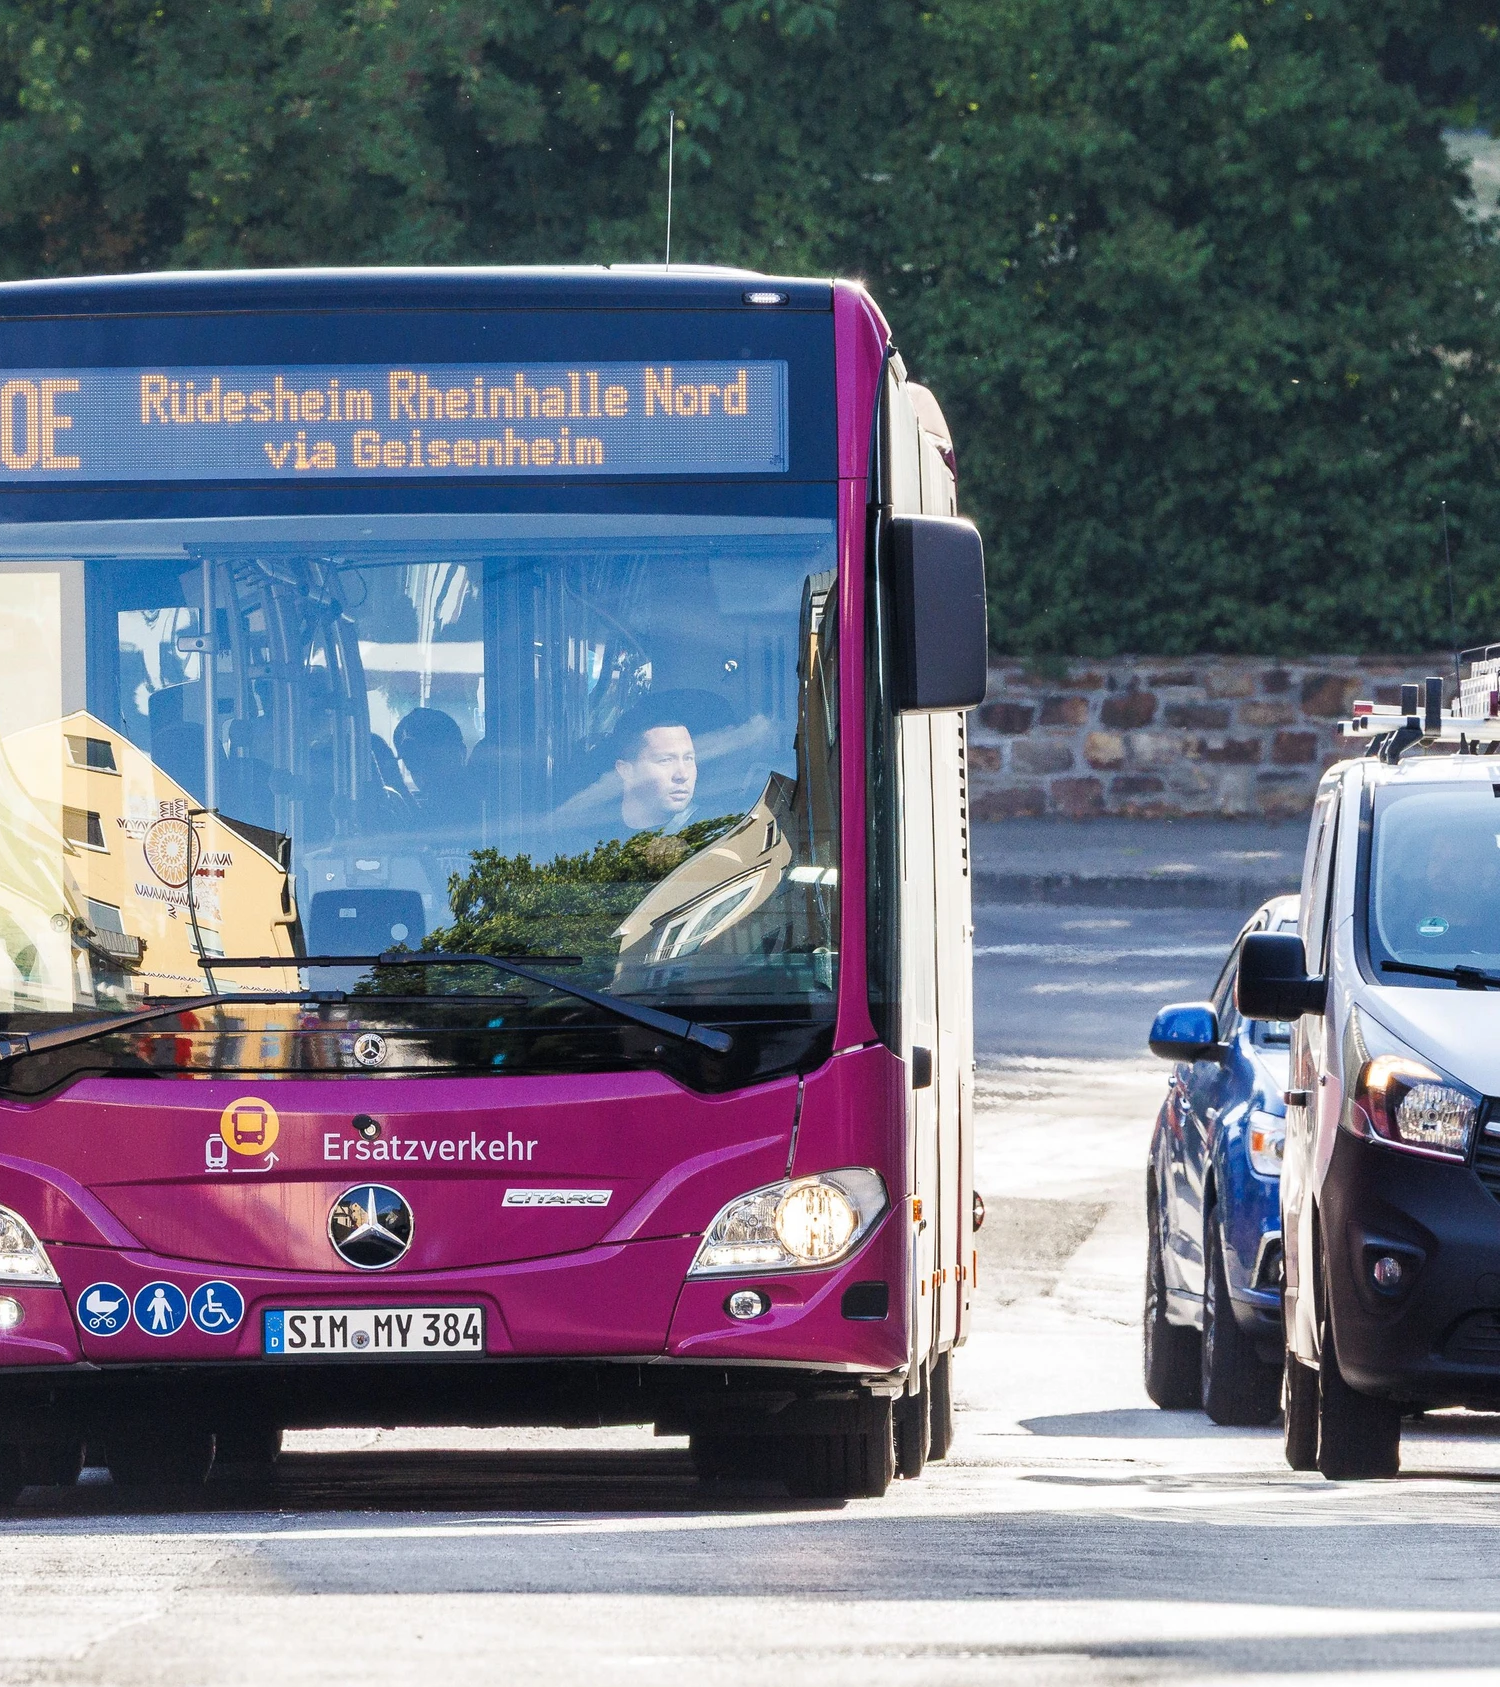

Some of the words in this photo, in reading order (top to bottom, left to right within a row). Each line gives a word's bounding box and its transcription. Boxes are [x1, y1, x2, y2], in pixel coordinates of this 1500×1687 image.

[140, 374, 373, 423] Rüdesheim
[389, 370, 629, 421] Rheinhalle
[644, 367, 748, 417] Nord
[263, 430, 337, 470] via
[352, 427, 604, 468] Geisenheim
[323, 1131, 538, 1161] Ersatzverkehr
[506, 1191, 609, 1205] CITARO
[271, 1337, 279, 1348] D
[288, 1315, 348, 1349] SIM
[374, 1314, 413, 1348] MY
[422, 1313, 480, 1347] 384
